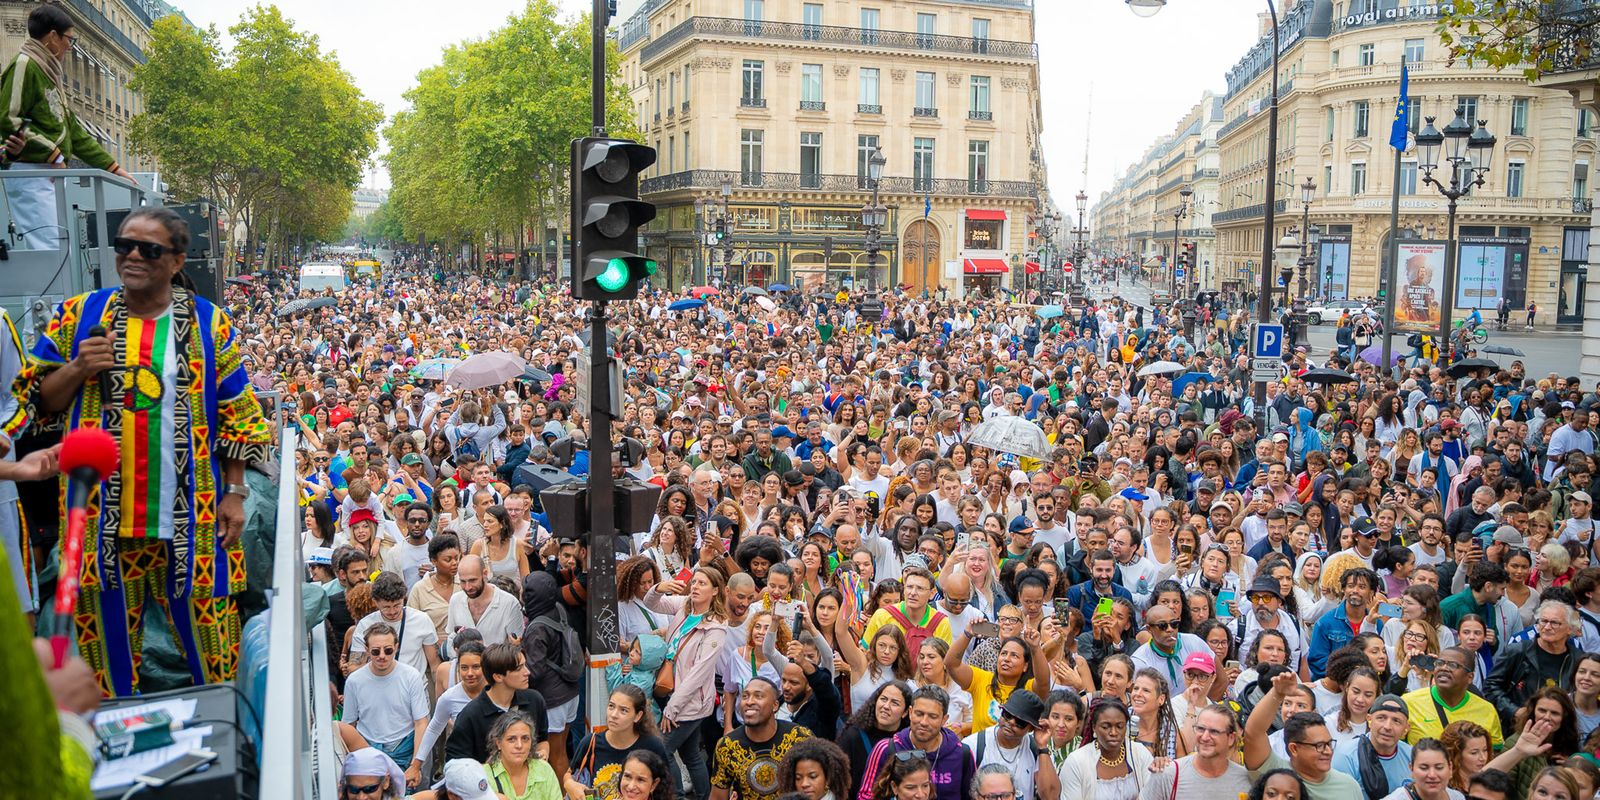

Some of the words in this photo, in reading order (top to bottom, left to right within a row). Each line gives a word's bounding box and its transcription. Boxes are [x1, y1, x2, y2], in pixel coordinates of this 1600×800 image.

[1341, 10, 1380, 26] royal
[1385, 7, 1419, 18] air
[1263, 331, 1275, 351] P
